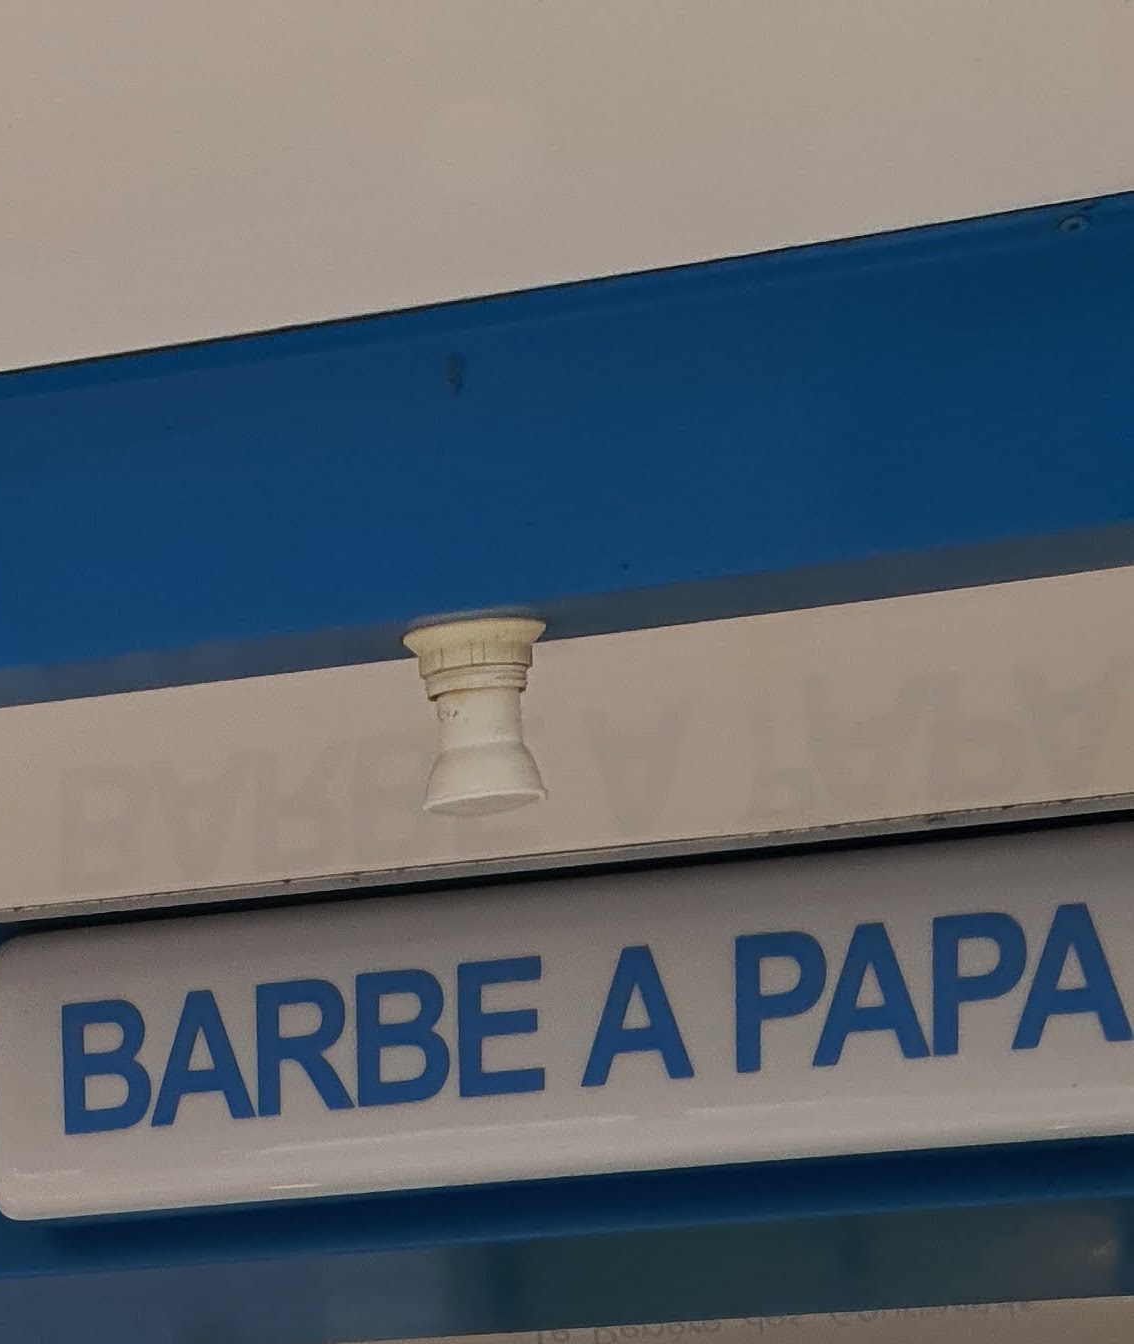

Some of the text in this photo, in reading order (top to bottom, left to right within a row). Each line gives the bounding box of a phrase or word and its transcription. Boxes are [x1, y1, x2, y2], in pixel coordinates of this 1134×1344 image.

[62, 902, 1133, 1135] BARBE A PAPA
